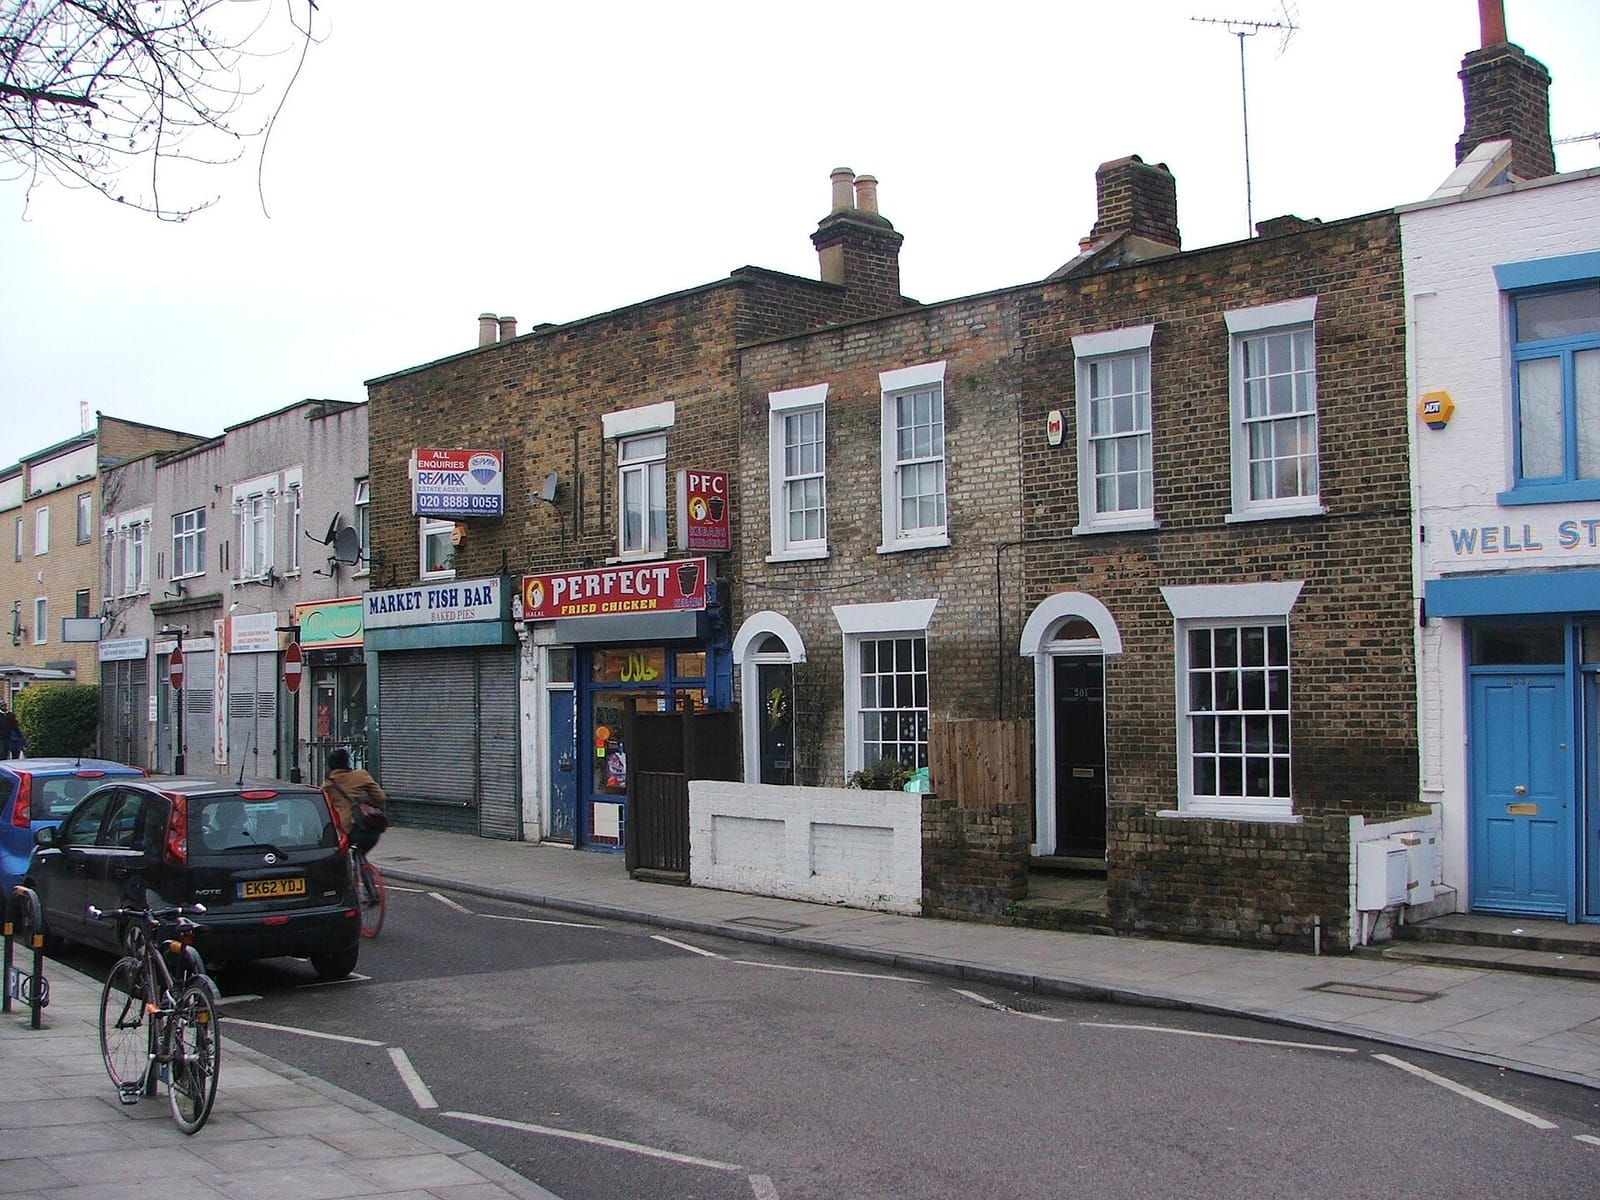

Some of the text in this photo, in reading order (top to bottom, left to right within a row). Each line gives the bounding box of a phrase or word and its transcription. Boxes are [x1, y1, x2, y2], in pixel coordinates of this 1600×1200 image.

[1424, 402, 1440, 413] ADT
[432, 451, 450, 459] ALL
[417, 460, 465, 469] ENQUIRIES
[418, 472, 465, 486] RE/MAX
[689, 474, 724, 493] PFC
[420, 495, 499, 508] 020 8888 0055
[1450, 524, 1543, 555] WELL
[551, 567, 670, 606] PERFECT
[369, 586, 493, 615] MARKET FISH BAR
[560, 599, 657, 615] FRIED CHICKEN
[431, 609, 475, 622] BAKED PIES
[217, 624, 226, 758] REMOVALS
[1074, 687, 1089, 697] 201
[246, 879, 303, 895] EK62 YDJ
